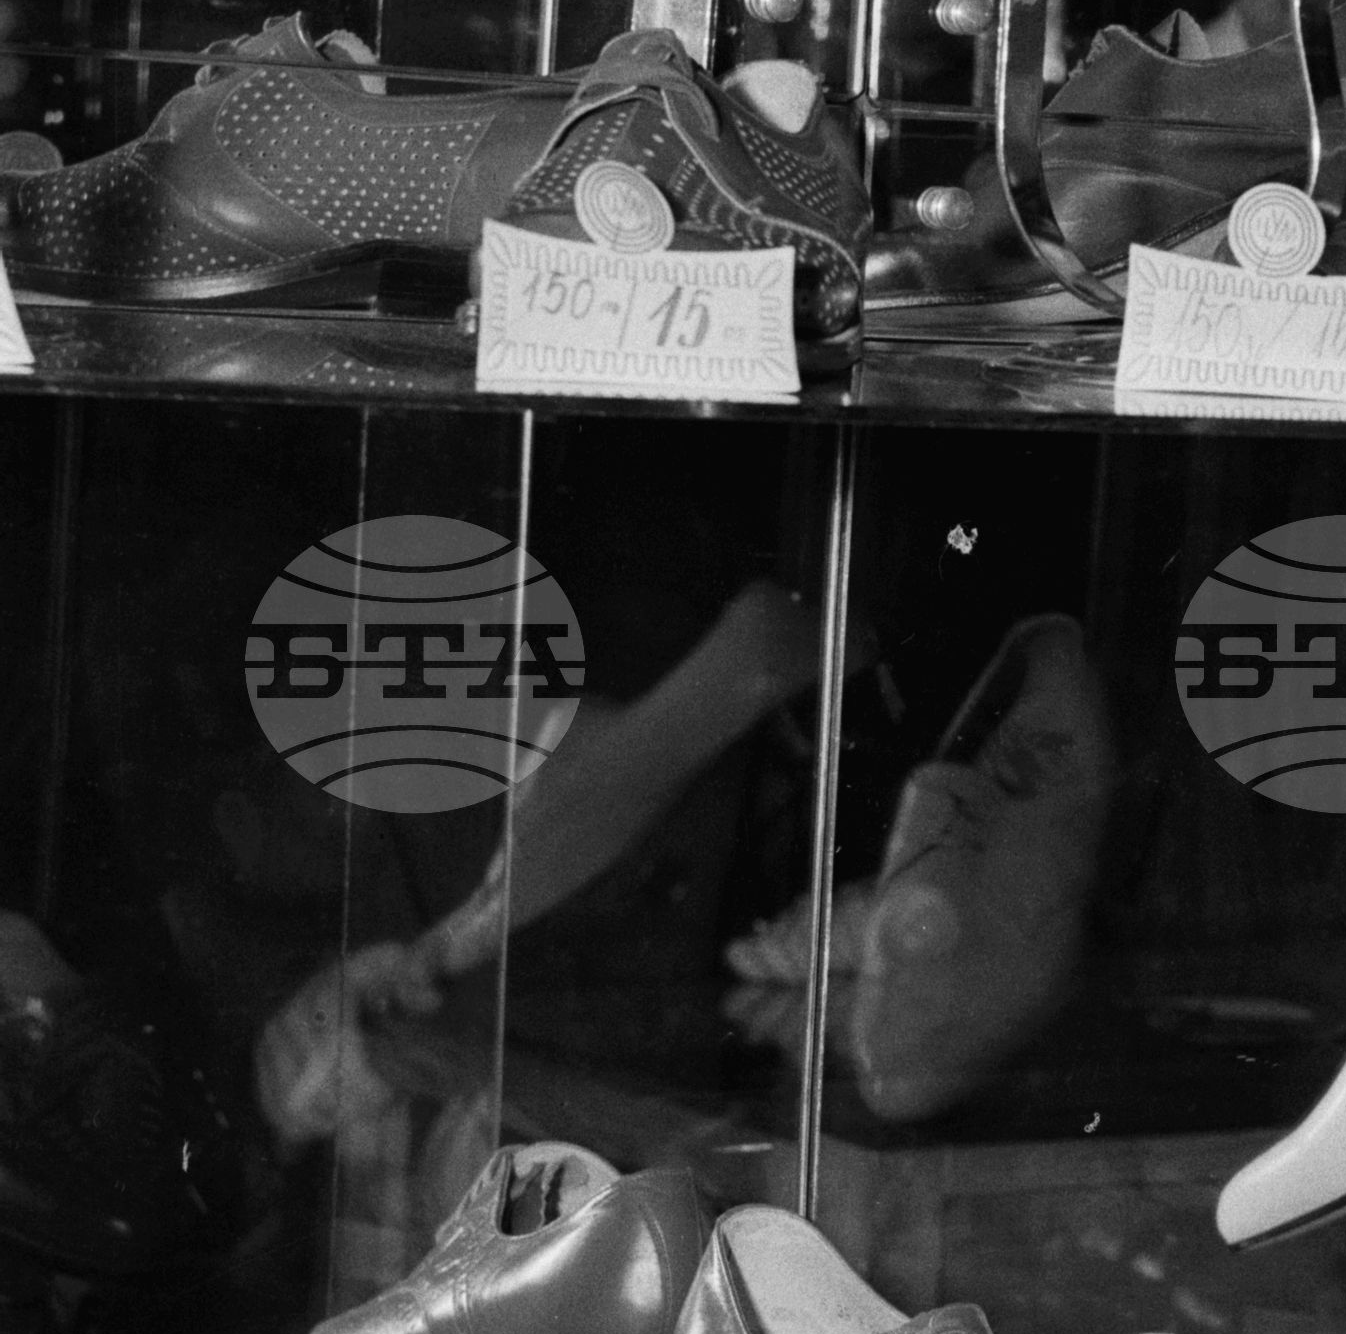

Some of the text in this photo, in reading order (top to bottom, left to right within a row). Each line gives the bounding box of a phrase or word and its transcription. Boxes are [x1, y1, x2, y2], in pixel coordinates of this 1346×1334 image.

[521, 270, 596, 320] 150
[647, 285, 714, 349] 15
[1166, 288, 1242, 357] 150
